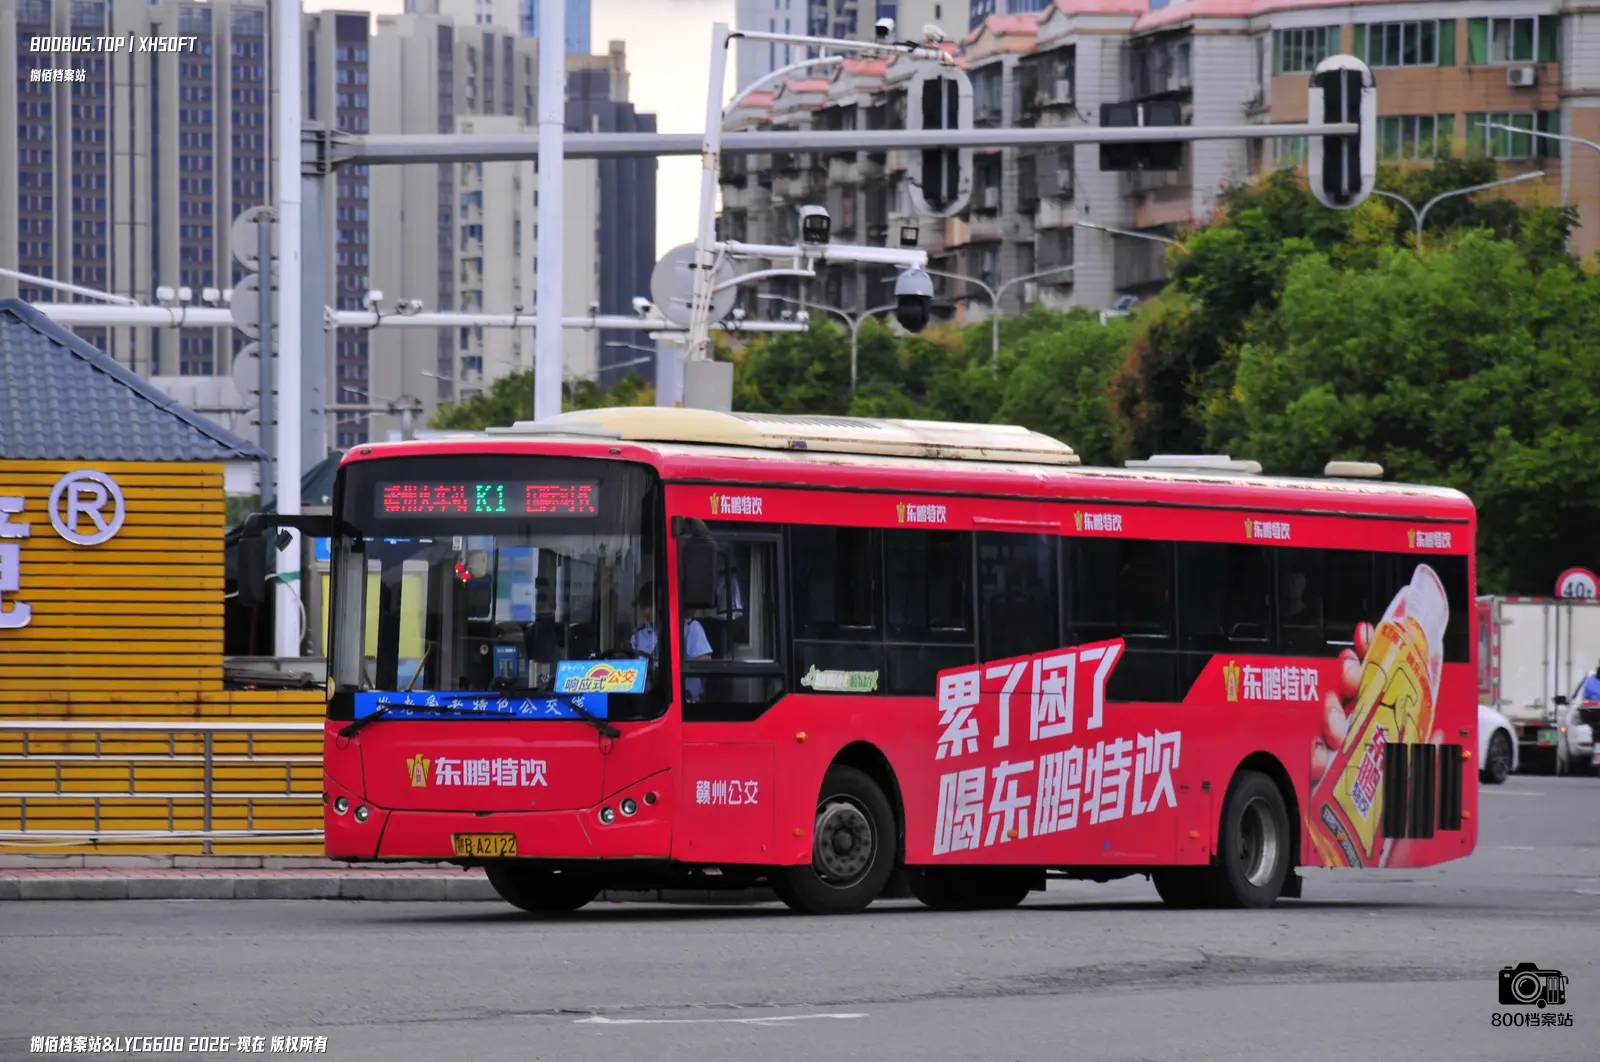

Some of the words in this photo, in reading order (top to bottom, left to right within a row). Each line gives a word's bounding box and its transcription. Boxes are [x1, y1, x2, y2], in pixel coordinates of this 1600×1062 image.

[475, 485, 506, 512] K1
[720, 494, 763, 515] 东鹏特饮
[906, 503, 947, 523] 东鹏特饮
[1084, 511, 1123, 532] 东鹏特饮
[1253, 519, 1291, 540] 东鹏特饮
[1415, 530, 1452, 549] 东鹏特饮
[565, 676, 607, 691] 响应式
[608, 669, 637, 684] 公交
[1242, 664, 1320, 701] 东鹏特饮
[935, 643, 1122, 760] 累了困了
[435, 757, 548, 787] 东鹏特饮
[696, 780, 758, 805] 赣州公交
[933, 728, 1182, 856] 喝东鹏特饮
